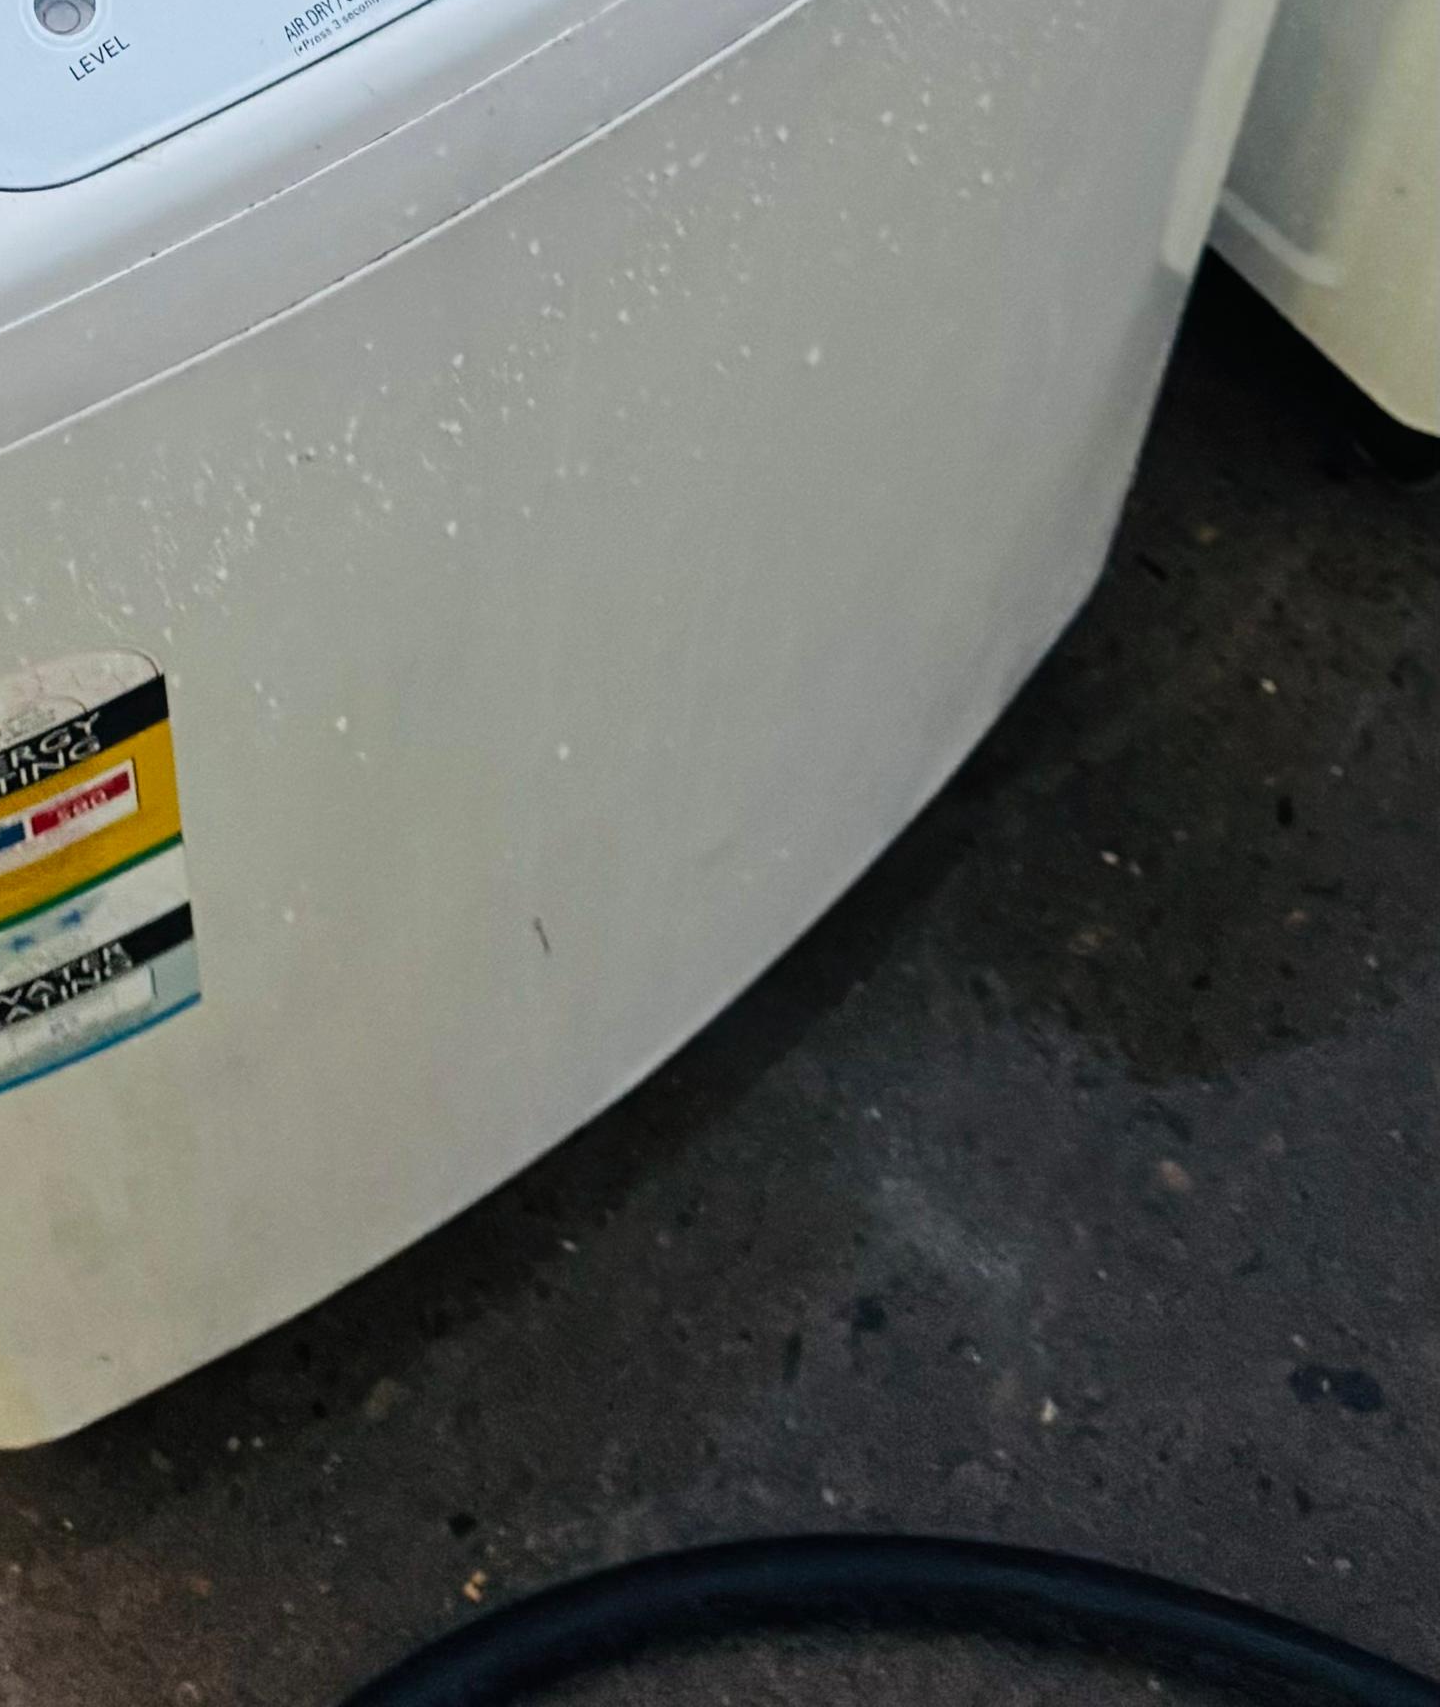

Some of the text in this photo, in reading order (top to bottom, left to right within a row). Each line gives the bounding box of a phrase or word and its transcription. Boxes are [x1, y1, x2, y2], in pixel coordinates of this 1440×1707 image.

[283, 13, 313, 44] AIR
[305, 0, 337, 28] DRY
[68, 36, 130, 82] LEVEL
